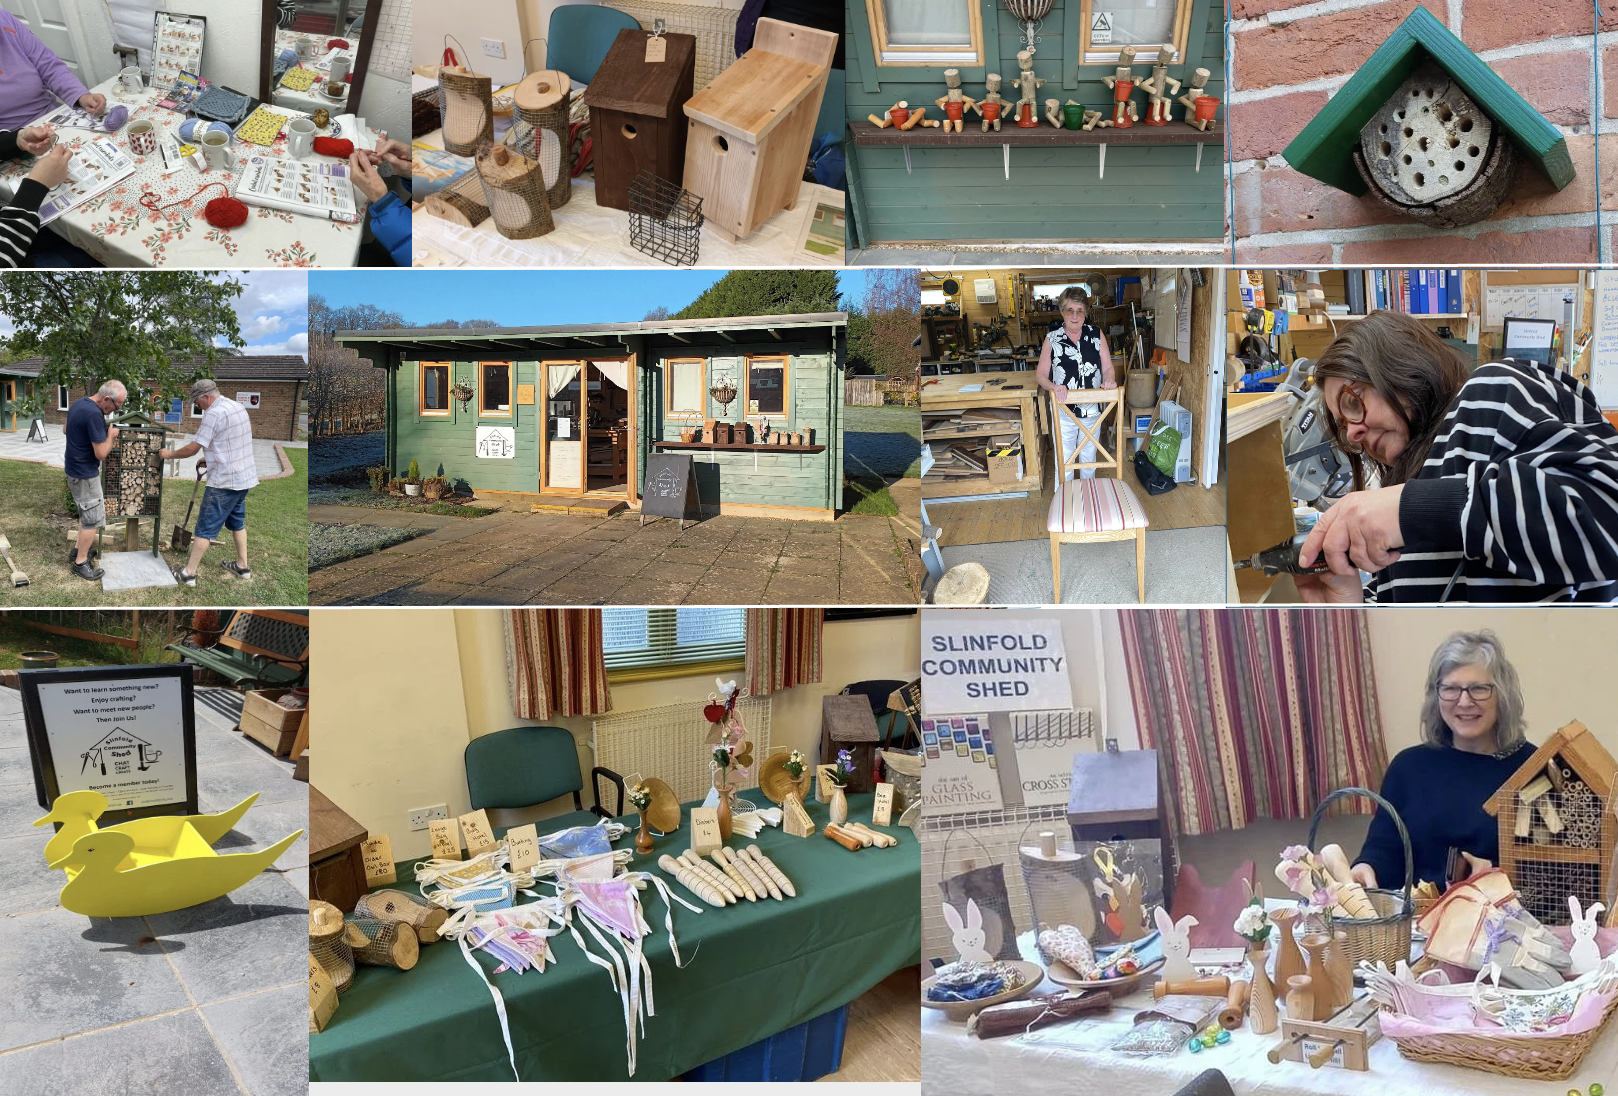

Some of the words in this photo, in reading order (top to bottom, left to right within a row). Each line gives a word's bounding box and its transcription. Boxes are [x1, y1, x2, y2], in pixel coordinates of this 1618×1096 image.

[932, 634, 1047, 652] SLINFOLD
[922, 657, 1063, 675] COMMUNITY
[966, 681, 1029, 697] SHED
[106, 736, 133, 745] Slinfold
[932, 782, 974, 793] GLASS
[1022, 779, 1058, 791] CROSS
[922, 790, 991, 805] PAINTING
[518, 850, 529, 859] £10
